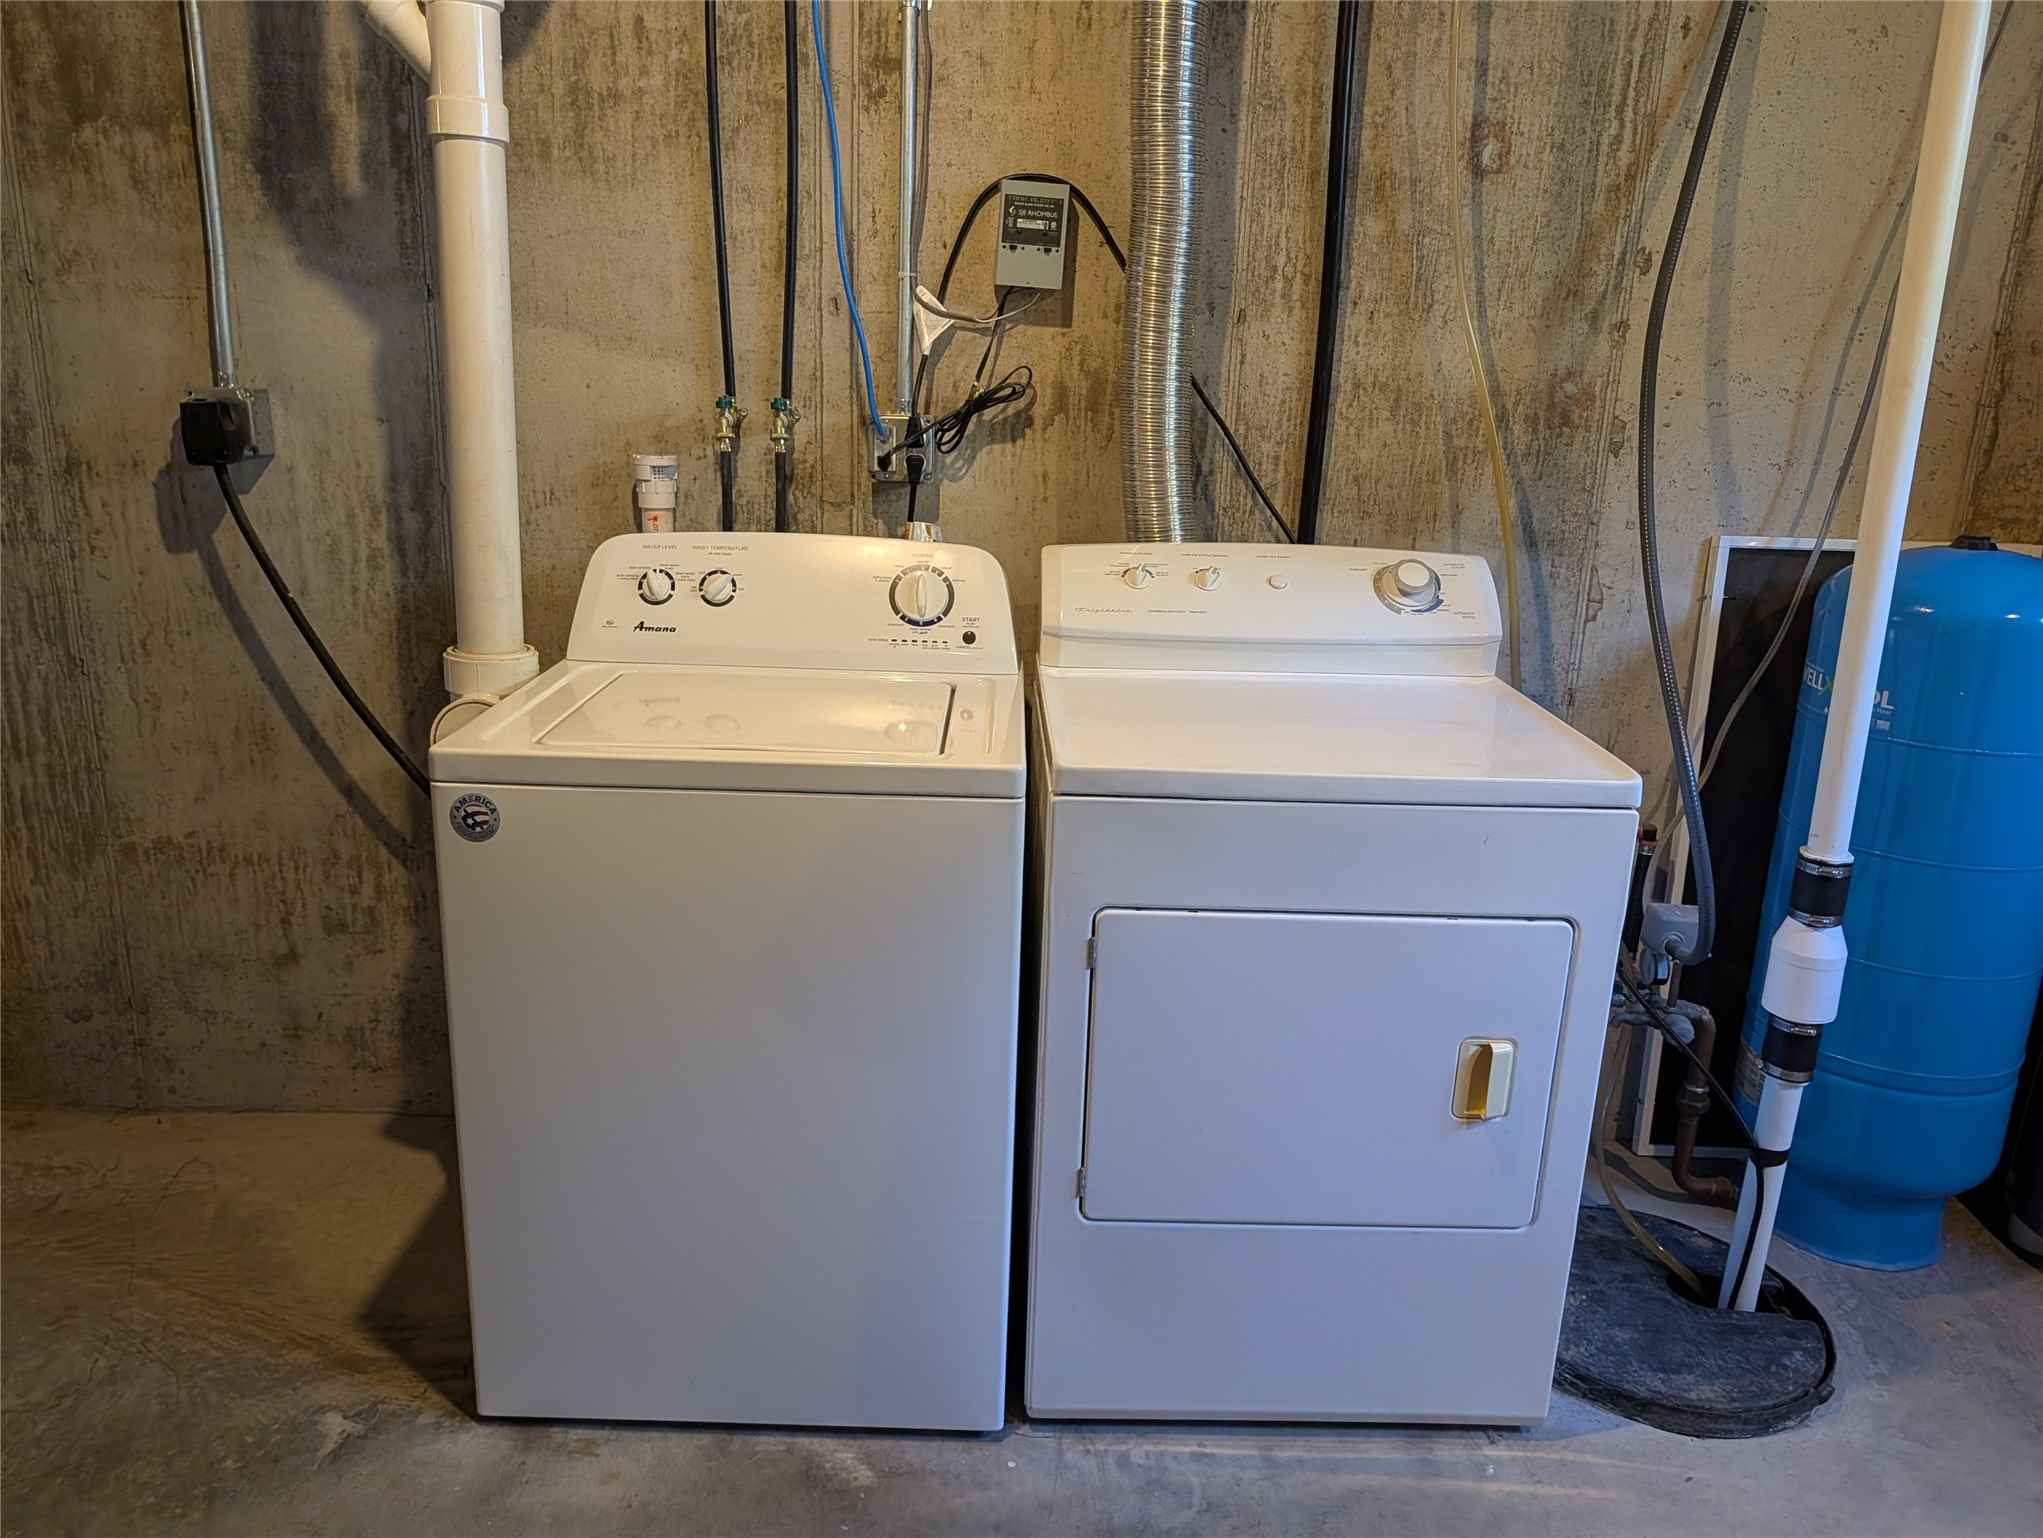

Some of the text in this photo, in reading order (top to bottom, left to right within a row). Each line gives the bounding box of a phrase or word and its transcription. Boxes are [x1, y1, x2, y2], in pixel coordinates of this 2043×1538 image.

[1028, 209, 1058, 218] RHOMBUS
[633, 621, 677, 633] Amana
[454, 795, 497, 815] AMERICA
